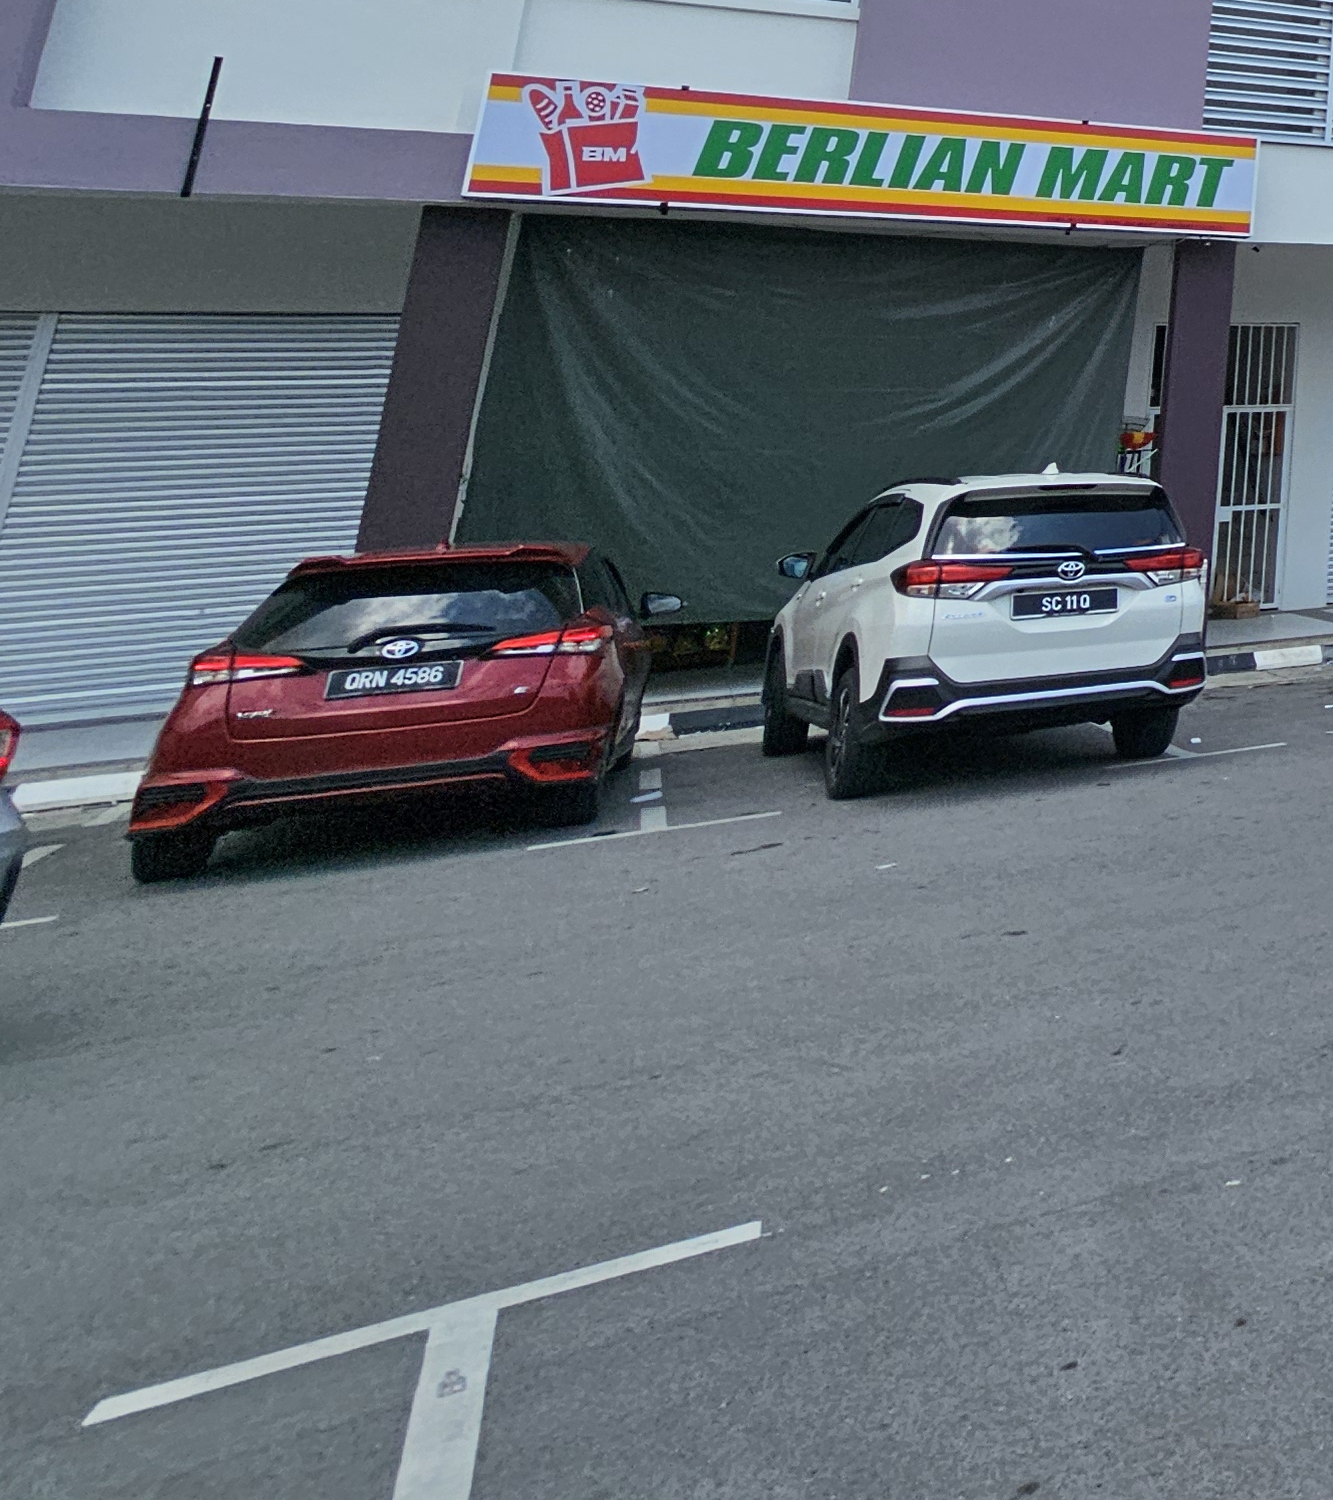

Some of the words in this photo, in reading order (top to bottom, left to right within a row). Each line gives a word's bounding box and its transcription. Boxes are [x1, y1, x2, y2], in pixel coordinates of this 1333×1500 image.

[581, 146, 627, 163] BM
[692, 118, 1026, 199] BERLIAN
[1034, 146, 1237, 209] MART
[1041, 596, 1062, 612] SC
[1065, 594, 1077, 610] 11
[1079, 594, 1090, 609] Q
[344, 670, 388, 690] QRN
[390, 665, 444, 686] 4586
